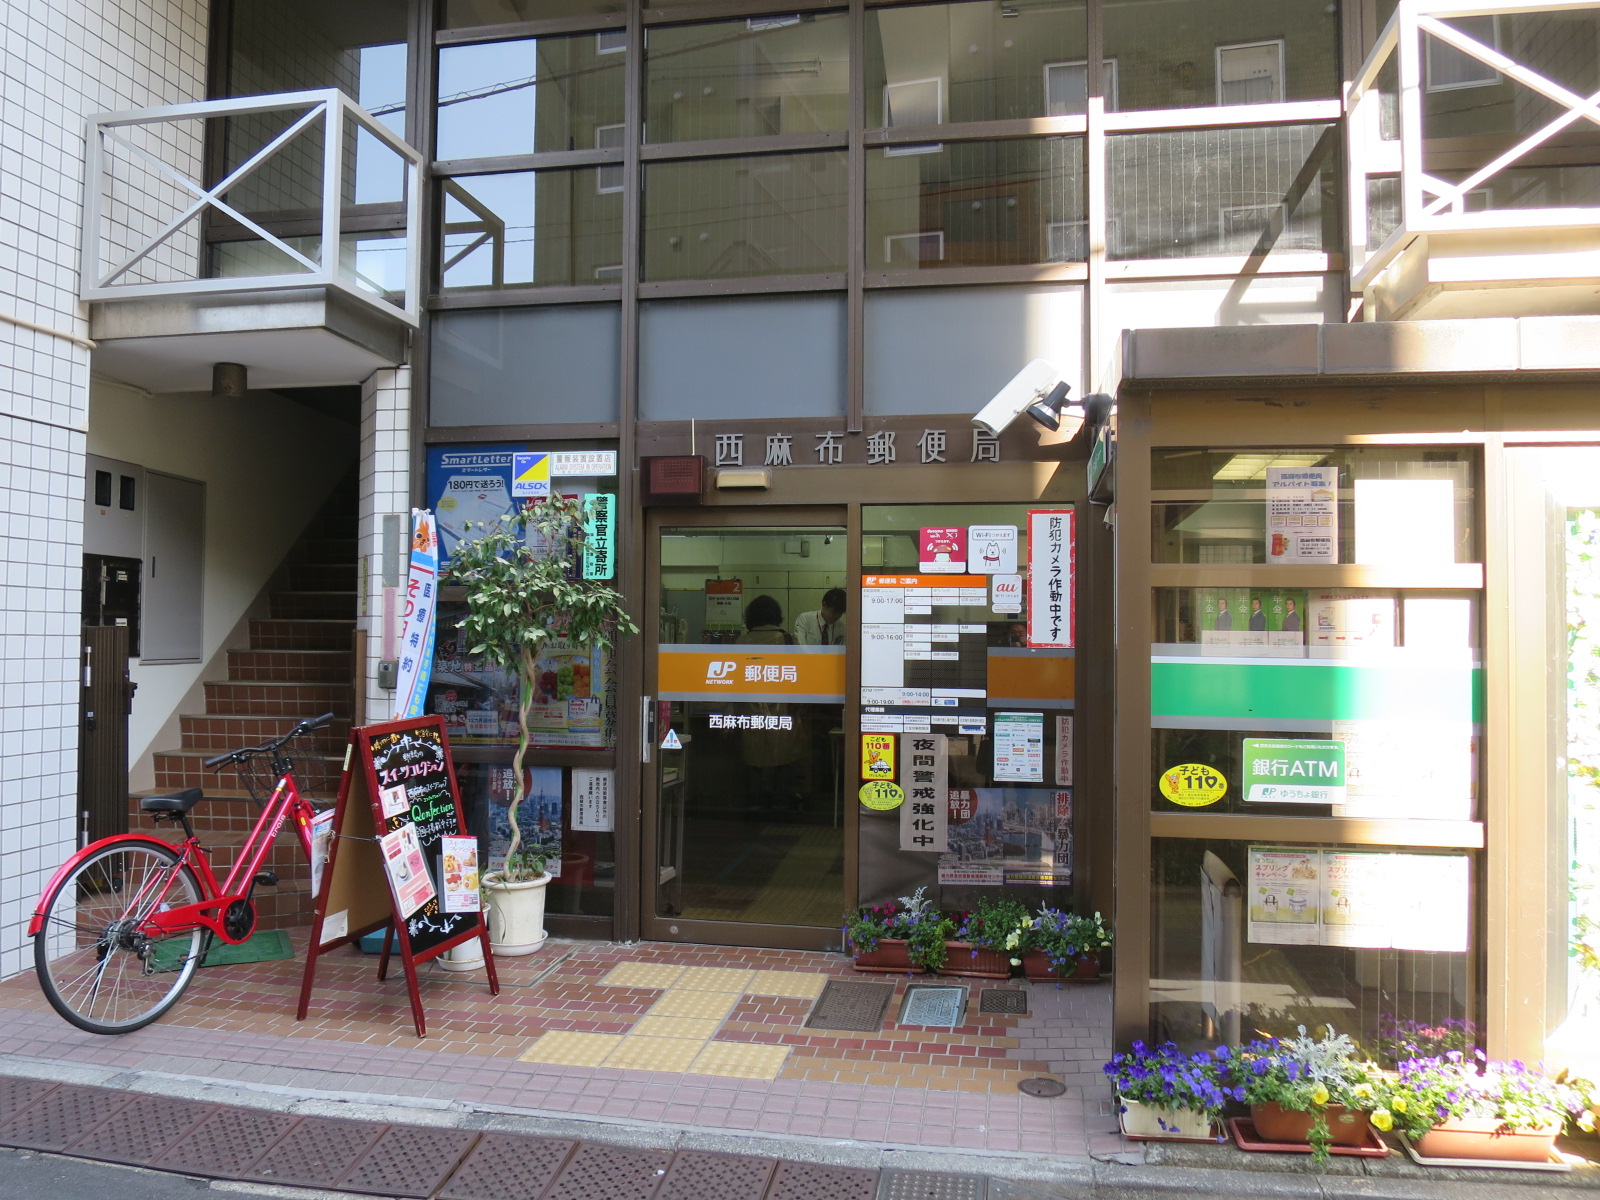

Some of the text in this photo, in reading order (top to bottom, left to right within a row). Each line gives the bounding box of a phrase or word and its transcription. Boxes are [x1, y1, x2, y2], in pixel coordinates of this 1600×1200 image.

[714, 428, 1000, 467] 西麻布郵便局
[441, 453, 512, 465] SmartLetter
[447, 480, 504, 490] 180円で送ろう!
[514, 482, 548, 490] ALSOK
[594, 496, 608, 577] 警察官立寄所
[1048, 516, 1063, 642] 防犯カメラ作動中です
[733, 582, 740, 593] 2
[996, 583, 1019, 593] au
[744, 664, 798, 683] 郵便局
[709, 714, 793, 731] 西麻布郵便局
[865, 742, 891, 750] 110番
[1060, 717, 1070, 783] 防犯カメラ作動中
[1179, 765, 1210, 776] 子ども
[1251, 758, 1338, 778] 銀行ATM
[872, 781, 893, 789] 子ども
[912, 738, 936, 847] 夜間警戒強化中
[1279, 789, 1329, 800] ゆうちょ銀行
[1057, 828, 1069, 865] 暴力団
[1255, 862, 1291, 872] スプリング
